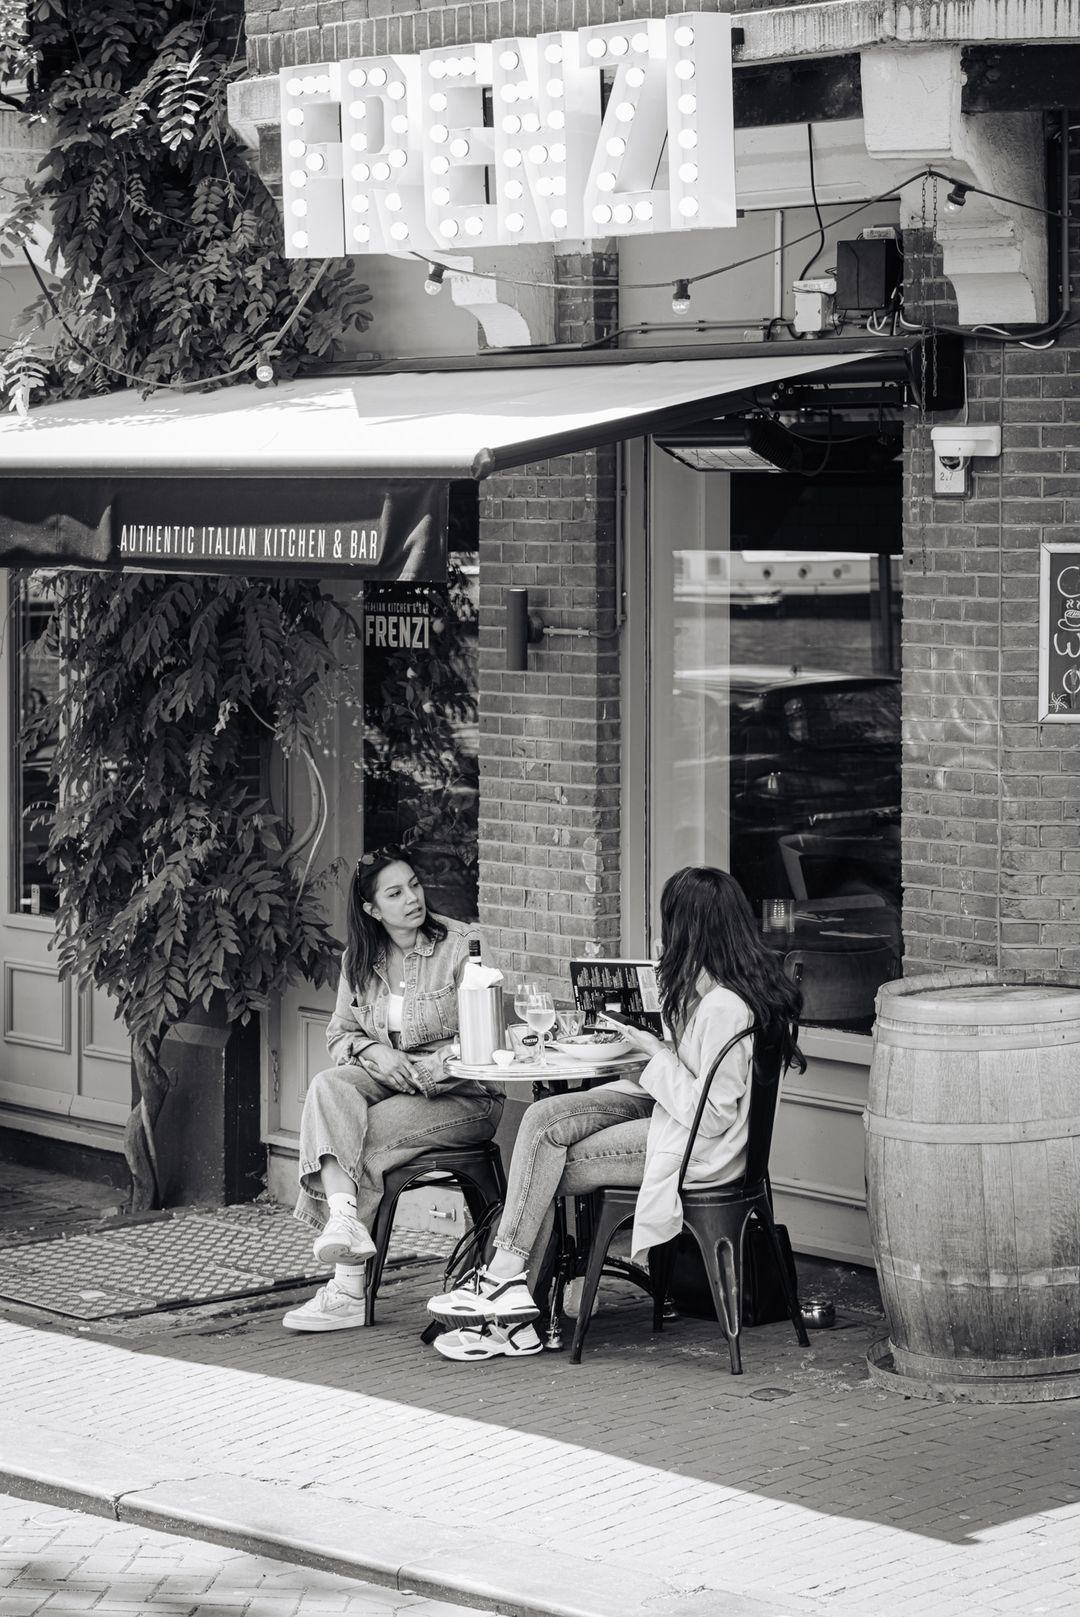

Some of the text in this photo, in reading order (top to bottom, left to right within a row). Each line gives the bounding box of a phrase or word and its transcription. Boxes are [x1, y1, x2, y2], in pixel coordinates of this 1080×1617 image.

[279, 12, 737, 258] FRENZI
[119, 524, 378, 559] AUTHENTIC ITALIAN KITCHEN & BAR
[387, 602, 411, 613] KITCHEN
[365, 615, 430, 649] FRENZI
